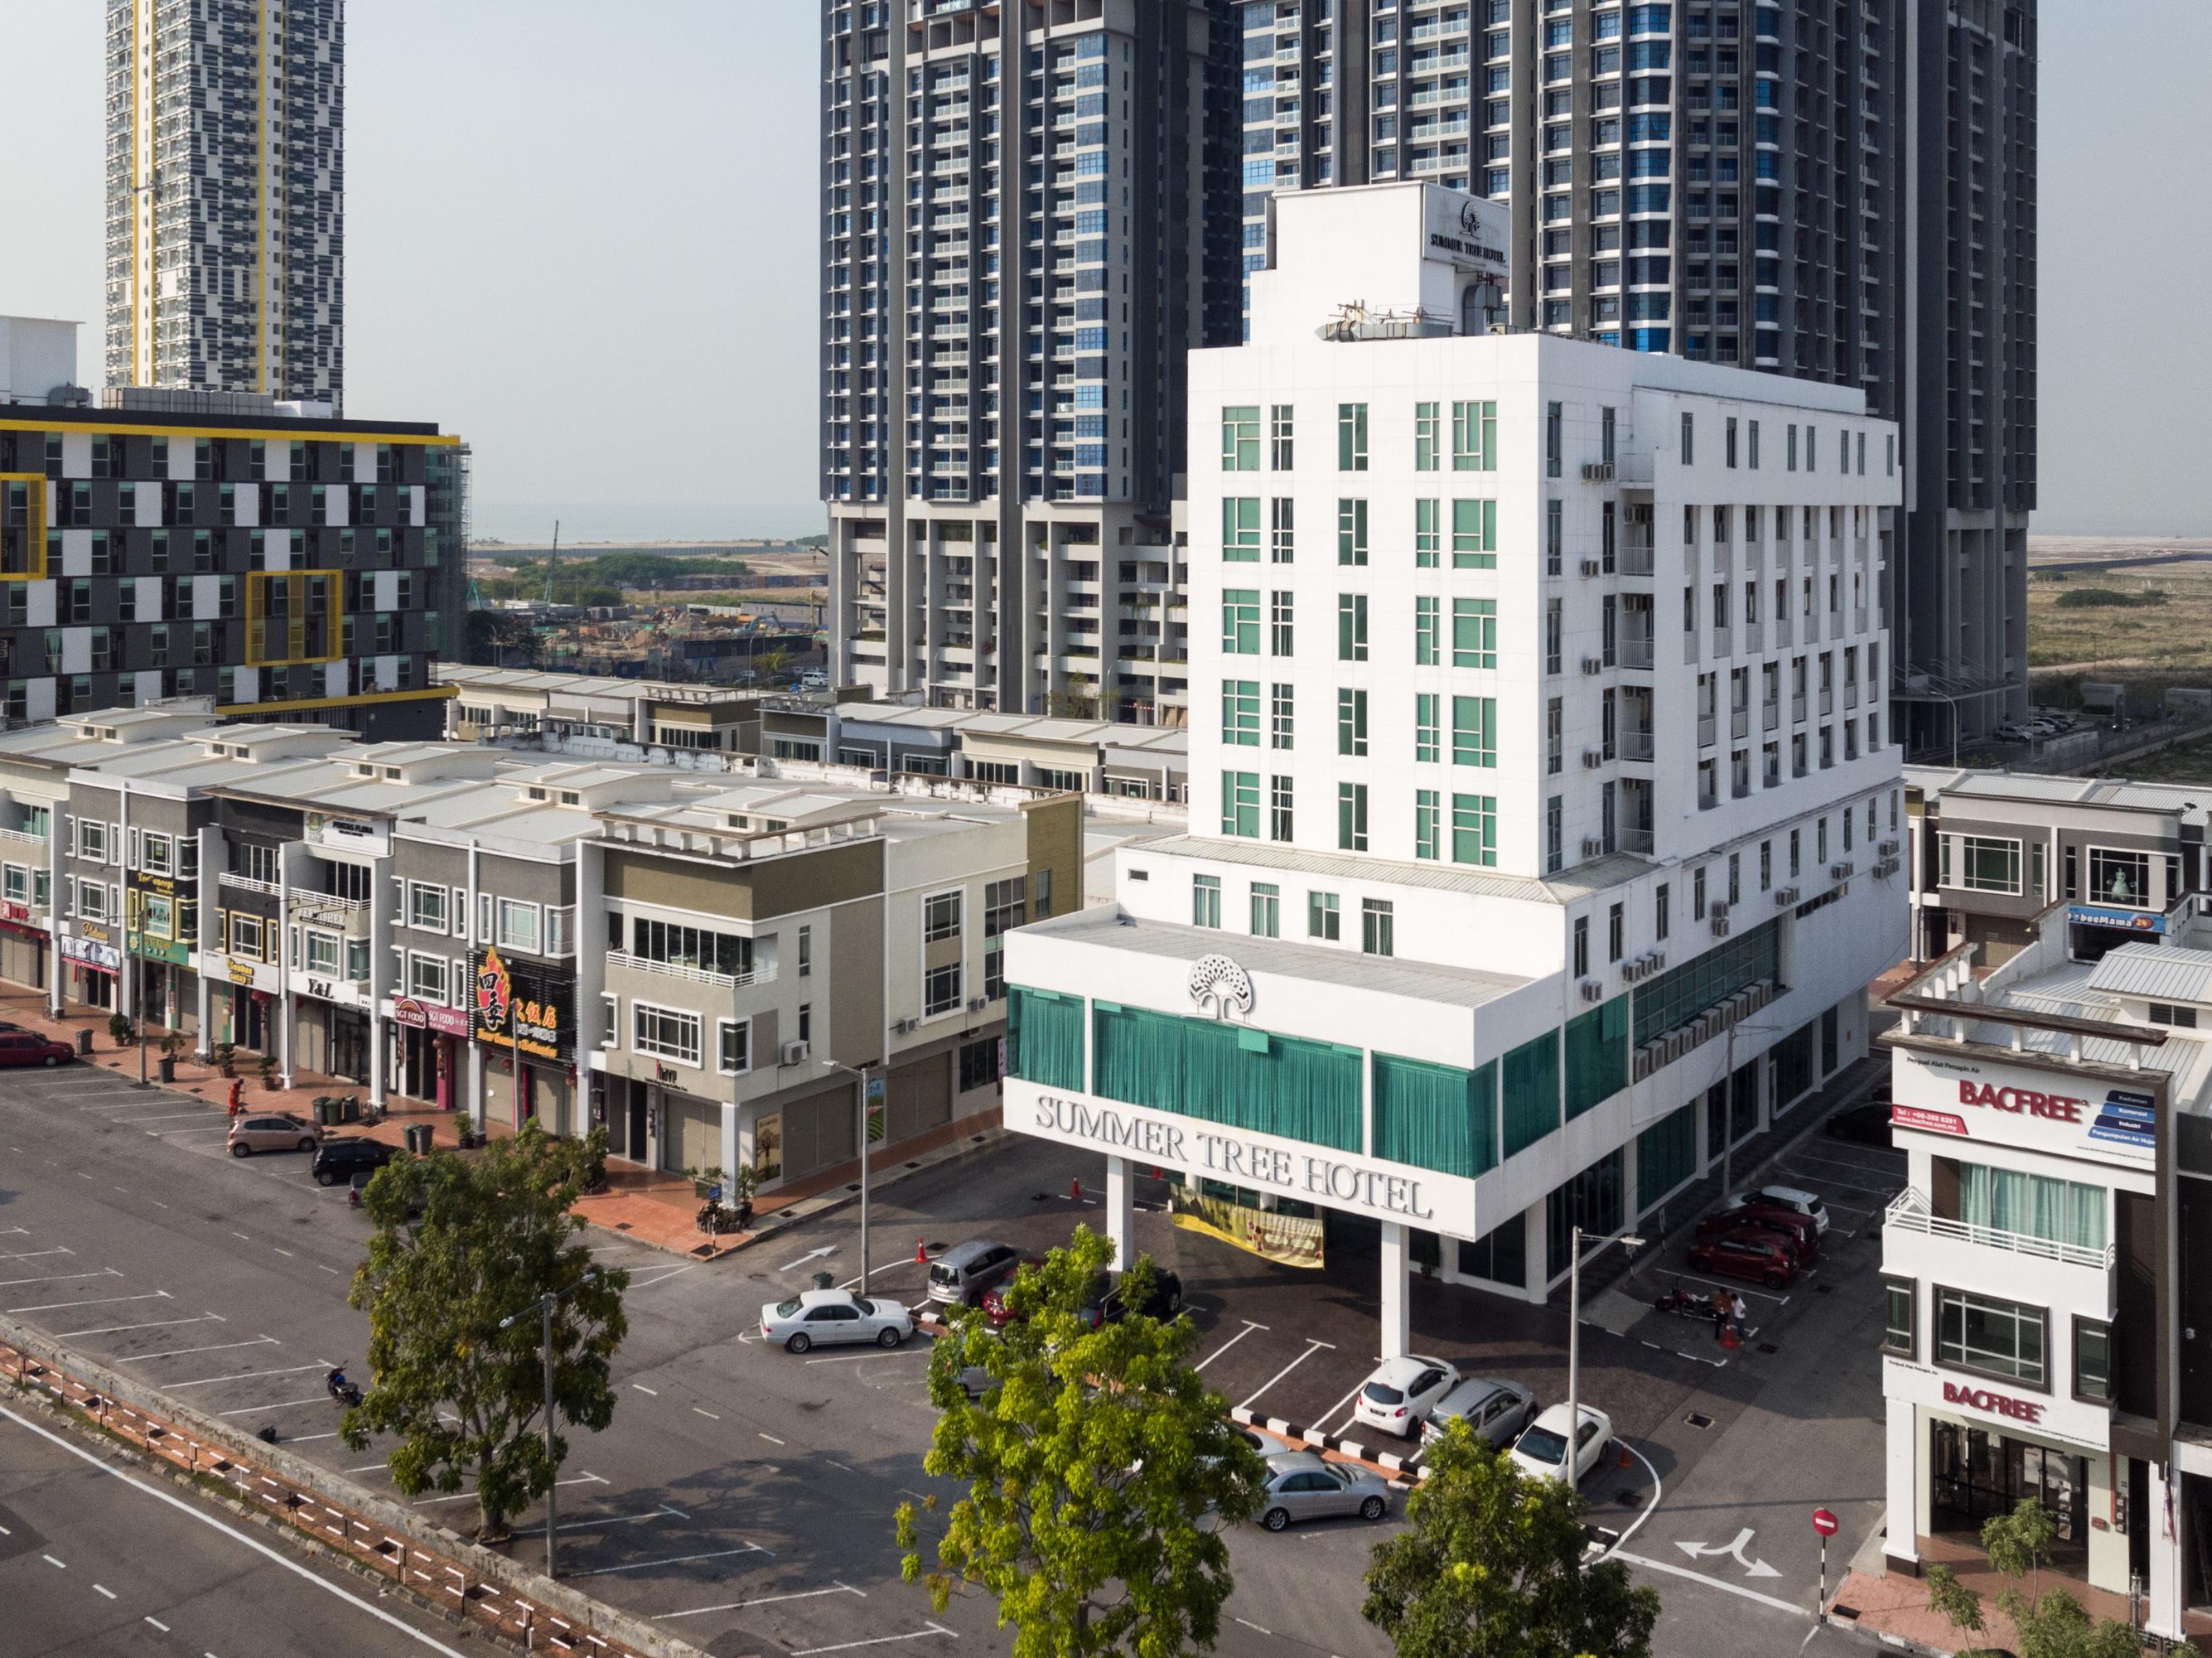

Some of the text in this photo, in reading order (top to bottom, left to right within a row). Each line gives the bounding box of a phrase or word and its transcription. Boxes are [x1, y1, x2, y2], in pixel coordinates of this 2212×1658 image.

[1431, 233, 1506, 263] SUMMER TREE HOTEL
[308, 979, 336, 999] Y&L
[396, 1009, 424, 1023] SGT FOOD
[439, 1013, 455, 1026] FOOD
[1906, 1056, 1930, 1066] Penjual
[1944, 1062, 1969, 1072] Penapis
[1959, 1079, 2083, 1124] BACFREE
[2118, 1108, 2148, 1117] Komersial
[2118, 1120, 2142, 1129] Industri
[2092, 1129, 2131, 1141] Pengumpulan
[1036, 1094, 1432, 1219] SUMMER TREE HOTEL
[1944, 1380, 2040, 1424] BACFREE
